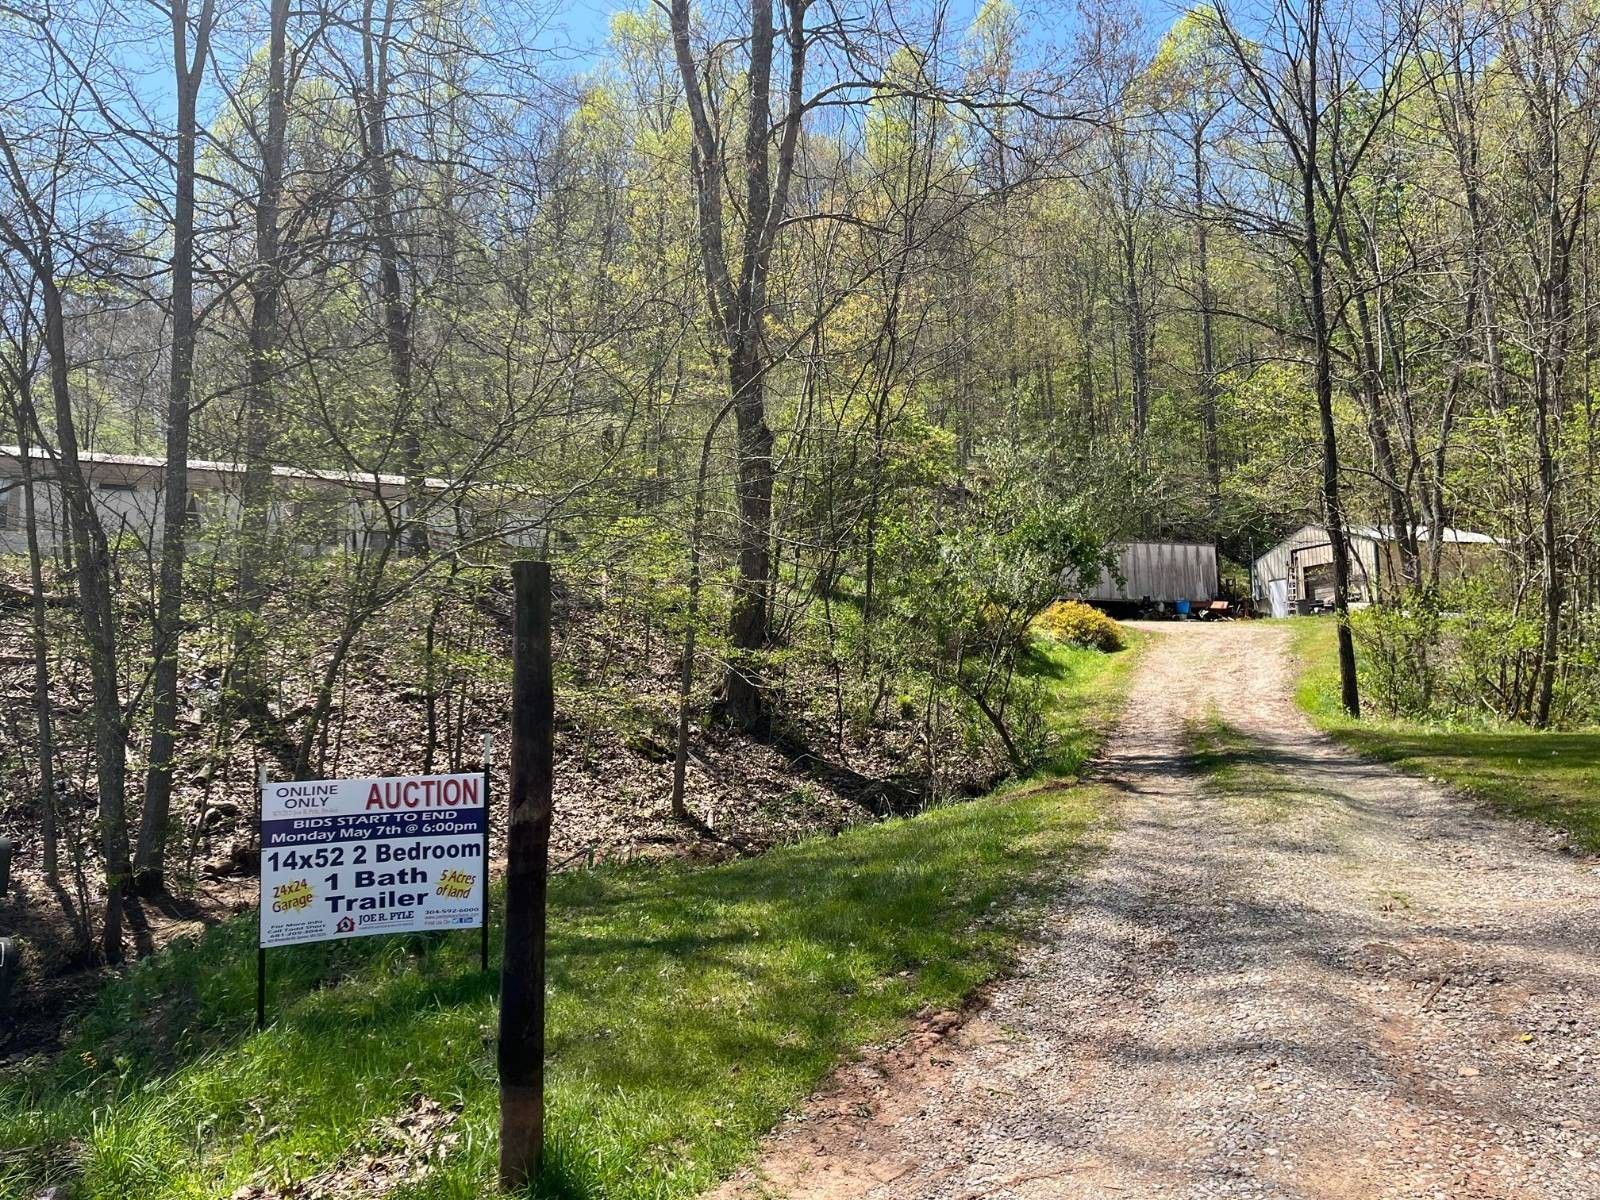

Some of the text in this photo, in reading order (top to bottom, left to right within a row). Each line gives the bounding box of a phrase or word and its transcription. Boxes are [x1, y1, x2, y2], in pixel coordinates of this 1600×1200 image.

[276, 785, 338, 797] ONLINE
[366, 778, 478, 810] AUCTION
[284, 797, 329, 809] ONLY
[293, 811, 457, 829] BIDS START TO END
[271, 822, 477, 843] Monday May 7th @ 6:00pm
[267, 842, 481, 872] 14x52 2 Bedroom
[324, 867, 428, 890] 1 Bath
[440, 869, 476, 885] 5 Acres
[272, 878, 308, 898] 24x24
[436, 884, 472, 899] of land
[272, 893, 313, 913] Garage
[324, 891, 429, 913] Trailer
[358, 913, 377, 926] JOE
[390, 910, 415, 921] PYLE
